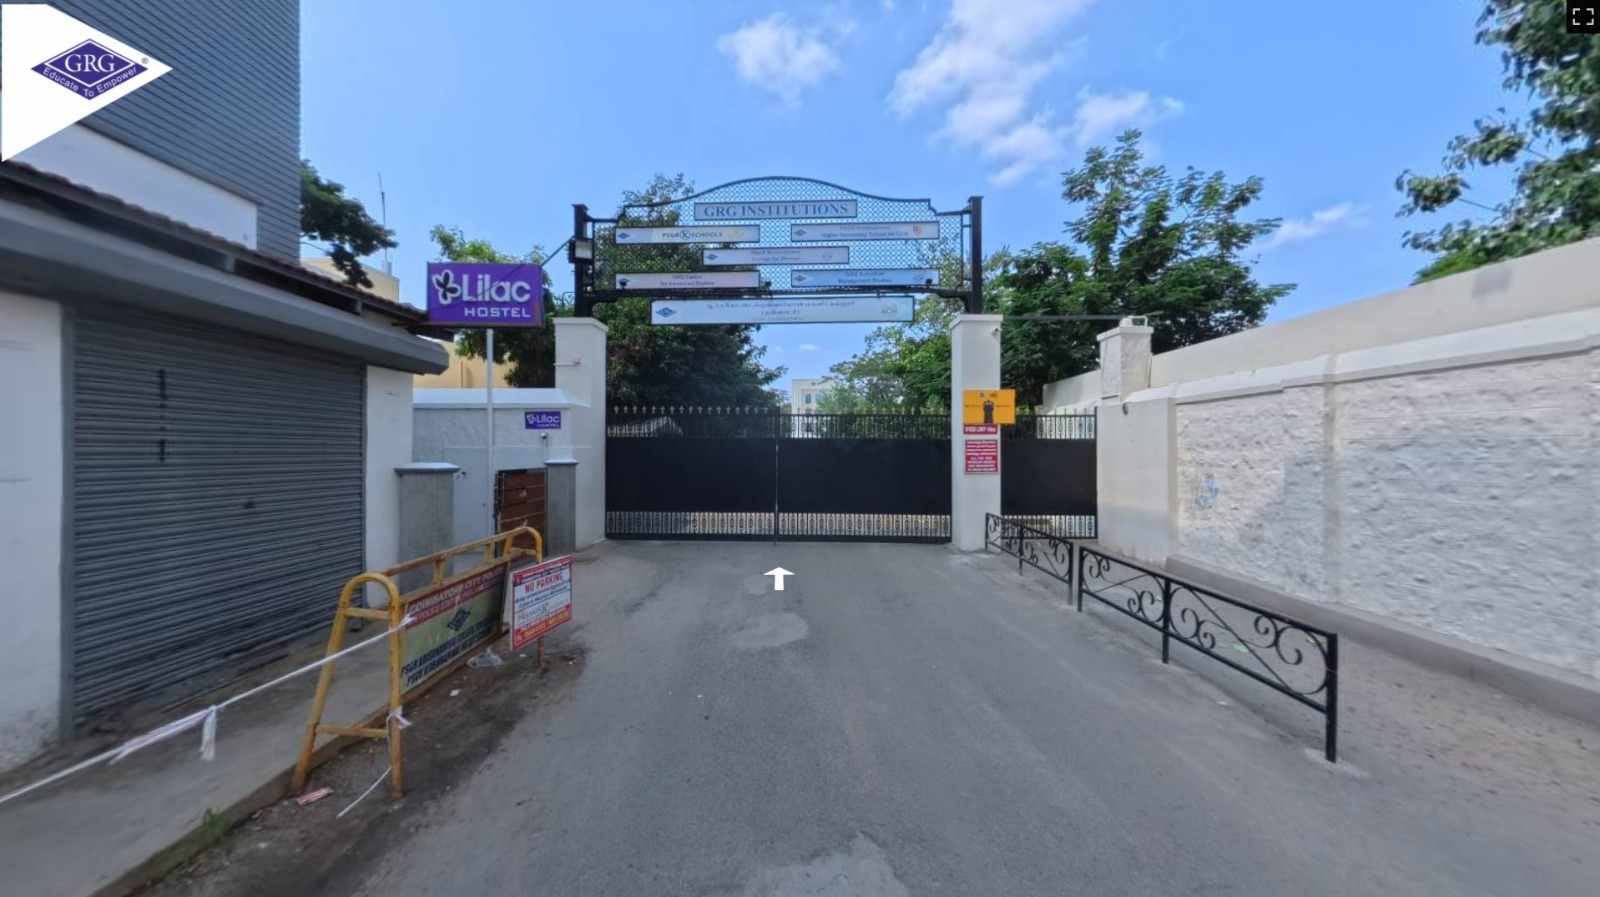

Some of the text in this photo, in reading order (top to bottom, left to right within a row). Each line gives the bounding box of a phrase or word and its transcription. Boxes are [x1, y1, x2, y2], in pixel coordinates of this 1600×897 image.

[704, 204, 848, 217] GRG INSTITUTIONS
[462, 274, 531, 303] Lilac
[464, 307, 532, 318] HOSTEL
[536, 414, 560, 423] Lilac
[525, 571, 564, 593] NO PARKING
